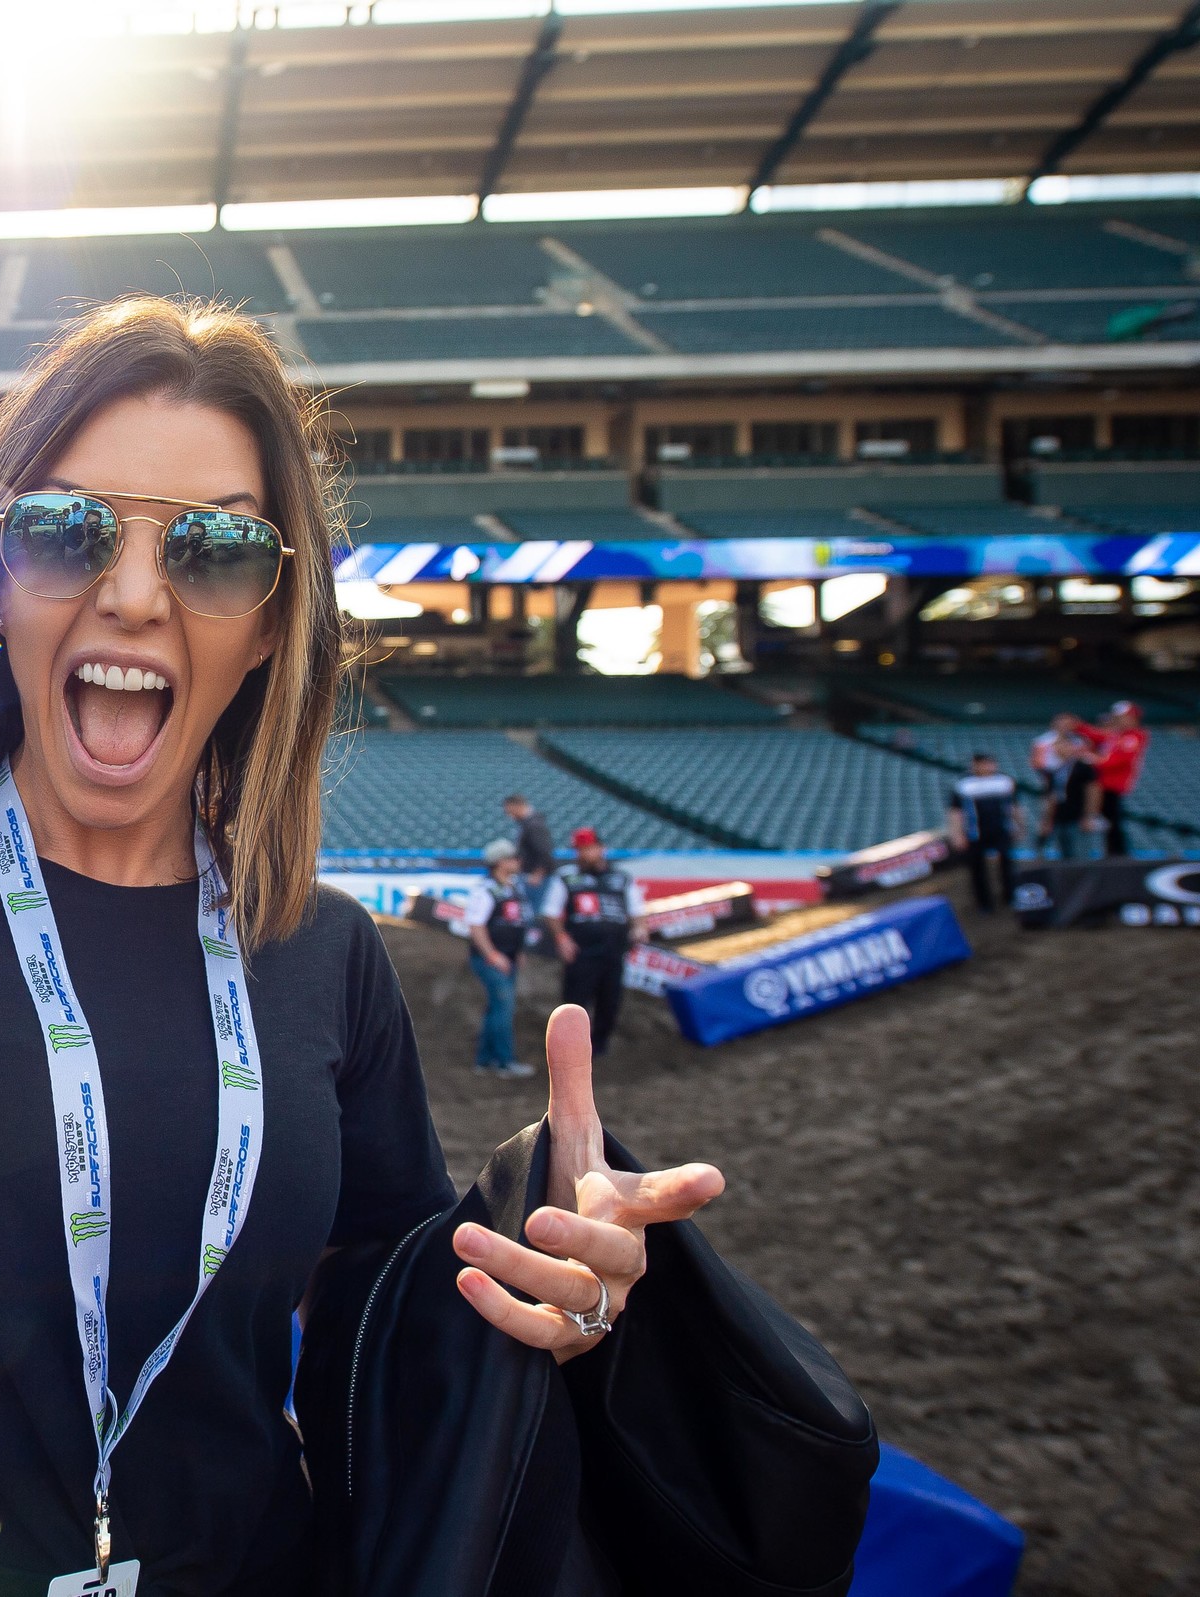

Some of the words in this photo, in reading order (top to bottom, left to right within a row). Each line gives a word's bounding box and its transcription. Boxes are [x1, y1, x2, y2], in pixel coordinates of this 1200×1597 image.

[26, 954, 50, 1003] MONSTER
[40, 932, 76, 1023] SUPERCROSS
[780, 926, 912, 998] YAMAHA
[227, 980, 249, 1067] SUPERCROSS
[63, 1112, 80, 1183] MONSTER
[75, 1121, 86, 1172] ENERGY
[80, 1081, 100, 1208] SUPERCROSS
[210, 1148, 230, 1216] MONSTER
[221, 1159, 234, 1208] ENERGY
[225, 1123, 250, 1248] SUPERCROSS
[83, 1310, 98, 1384] MONSTER
